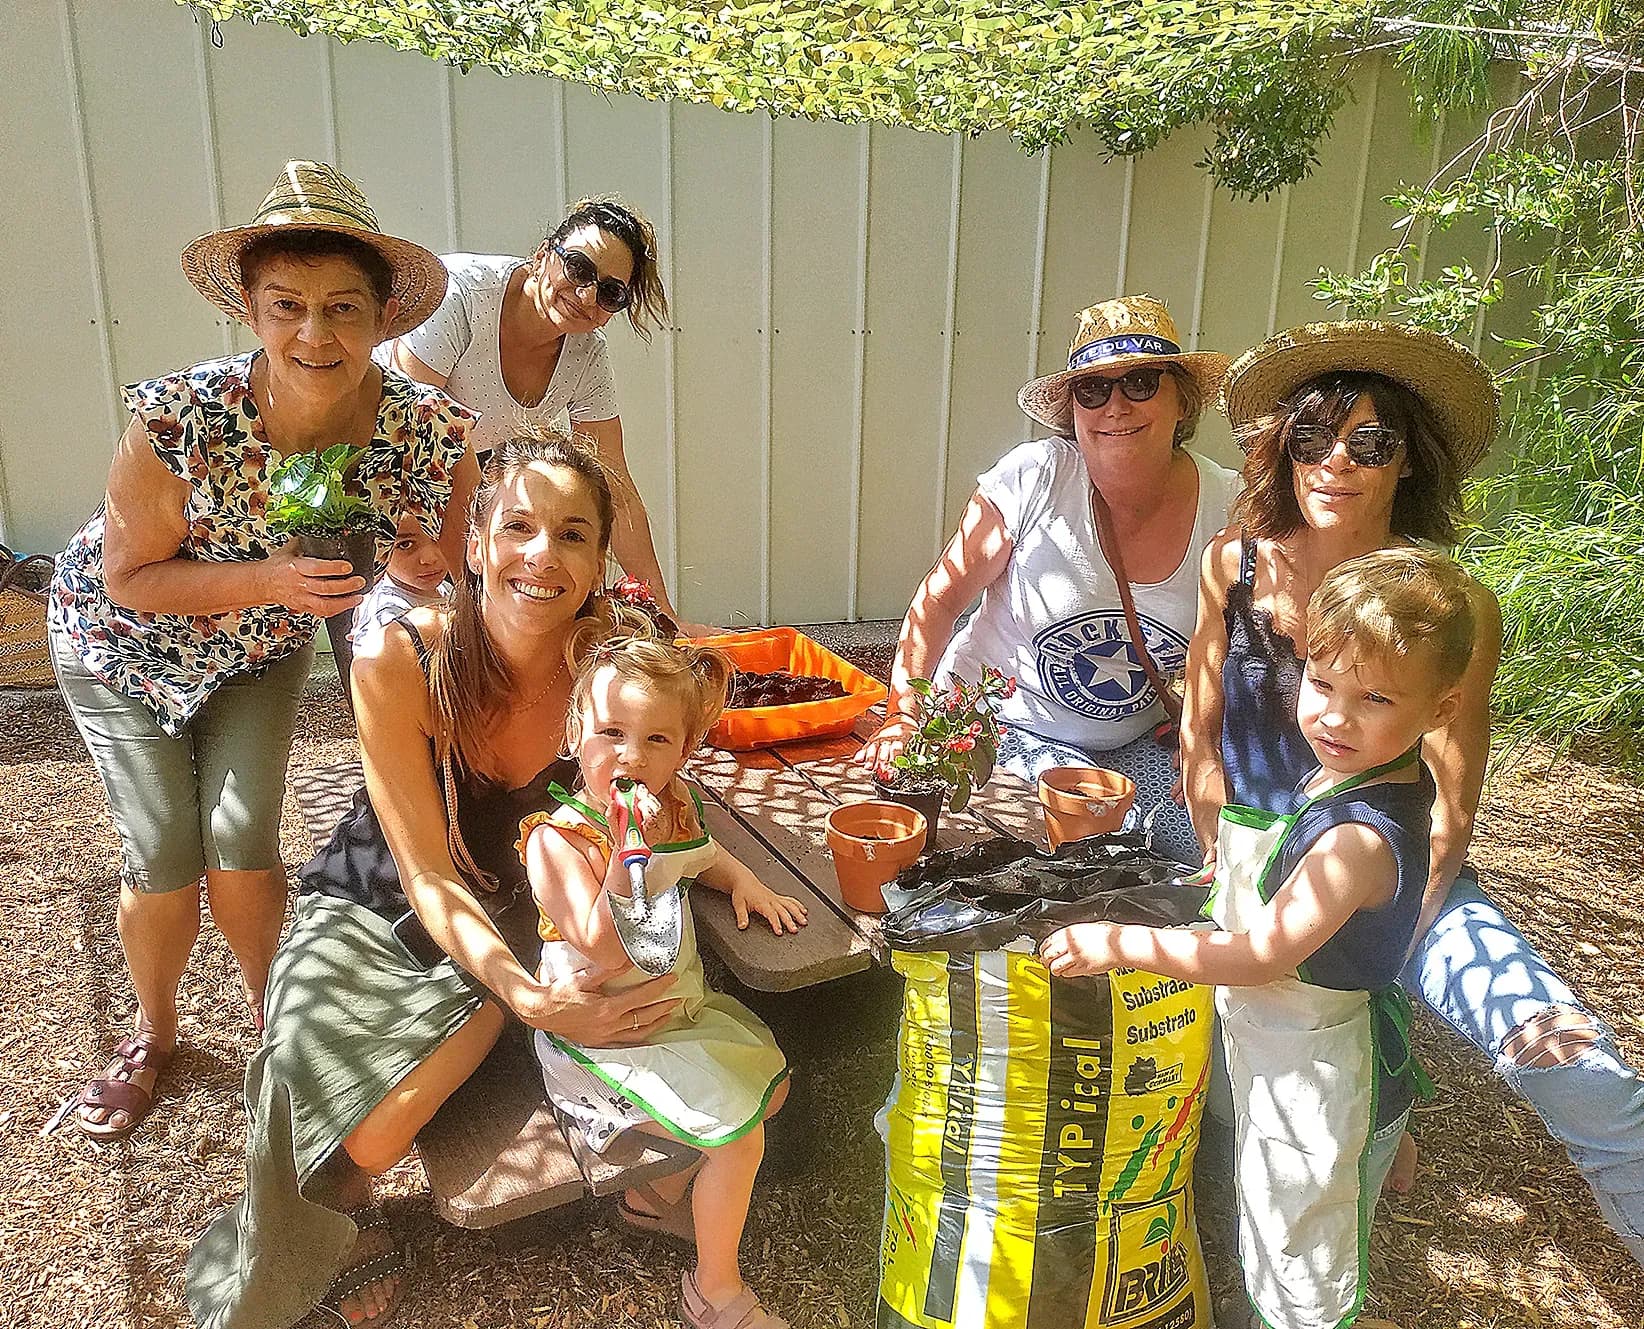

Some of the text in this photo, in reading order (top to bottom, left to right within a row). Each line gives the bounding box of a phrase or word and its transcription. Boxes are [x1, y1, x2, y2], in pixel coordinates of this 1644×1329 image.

[1102, 340, 1128, 354] DU
[1131, 337, 1162, 352] VAR
[1043, 619, 1123, 657] ROCK
[1052, 664, 1069, 689] ALL
[1065, 690, 1126, 717] ORIGINAL
[1126, 1008, 1196, 1045] Substrato
[1053, 1037, 1101, 1198] TYPical
